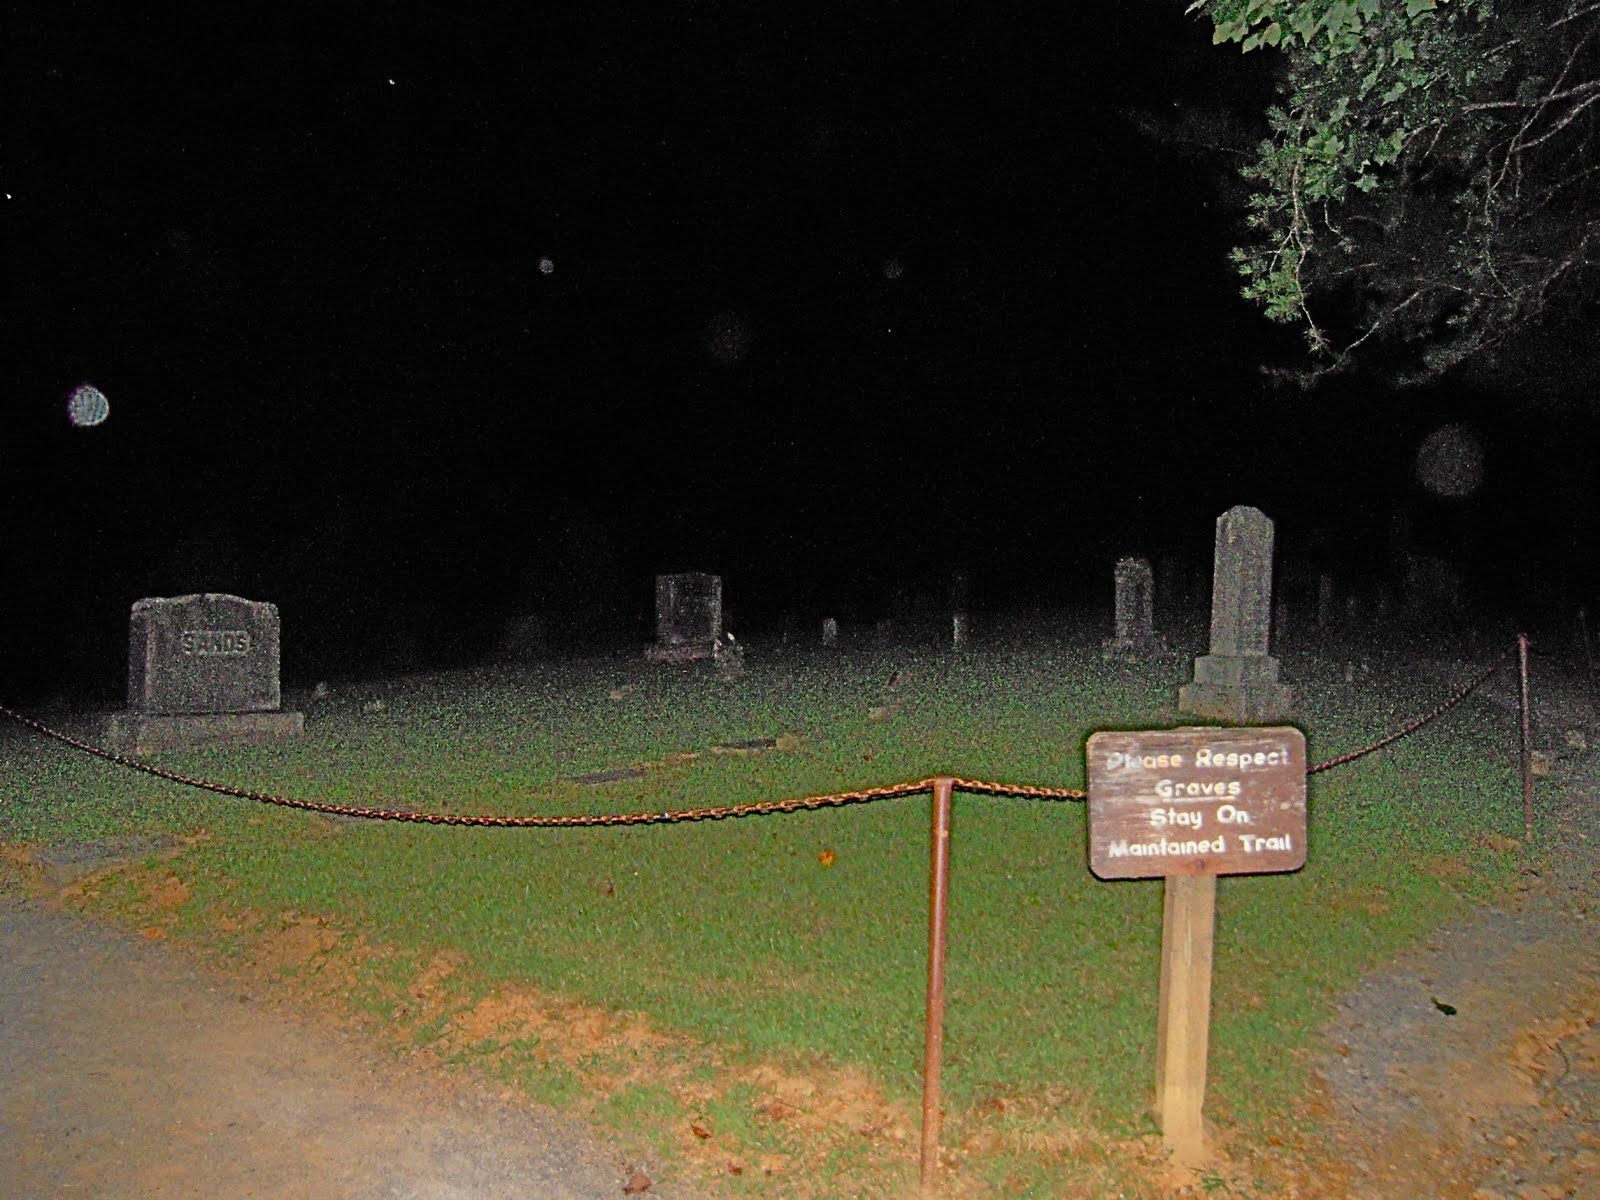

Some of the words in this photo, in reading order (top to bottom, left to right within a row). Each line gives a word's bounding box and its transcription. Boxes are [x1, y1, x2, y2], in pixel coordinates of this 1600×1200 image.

[1107, 751, 1182, 770] Please
[1195, 748, 1289, 771] Respect
[1155, 778, 1241, 797] Graves
[1150, 807, 1203, 829] Stay
[1216, 803, 1250, 824] On
[1108, 835, 1226, 858] Maintained
[1239, 833, 1292, 852] Trail
